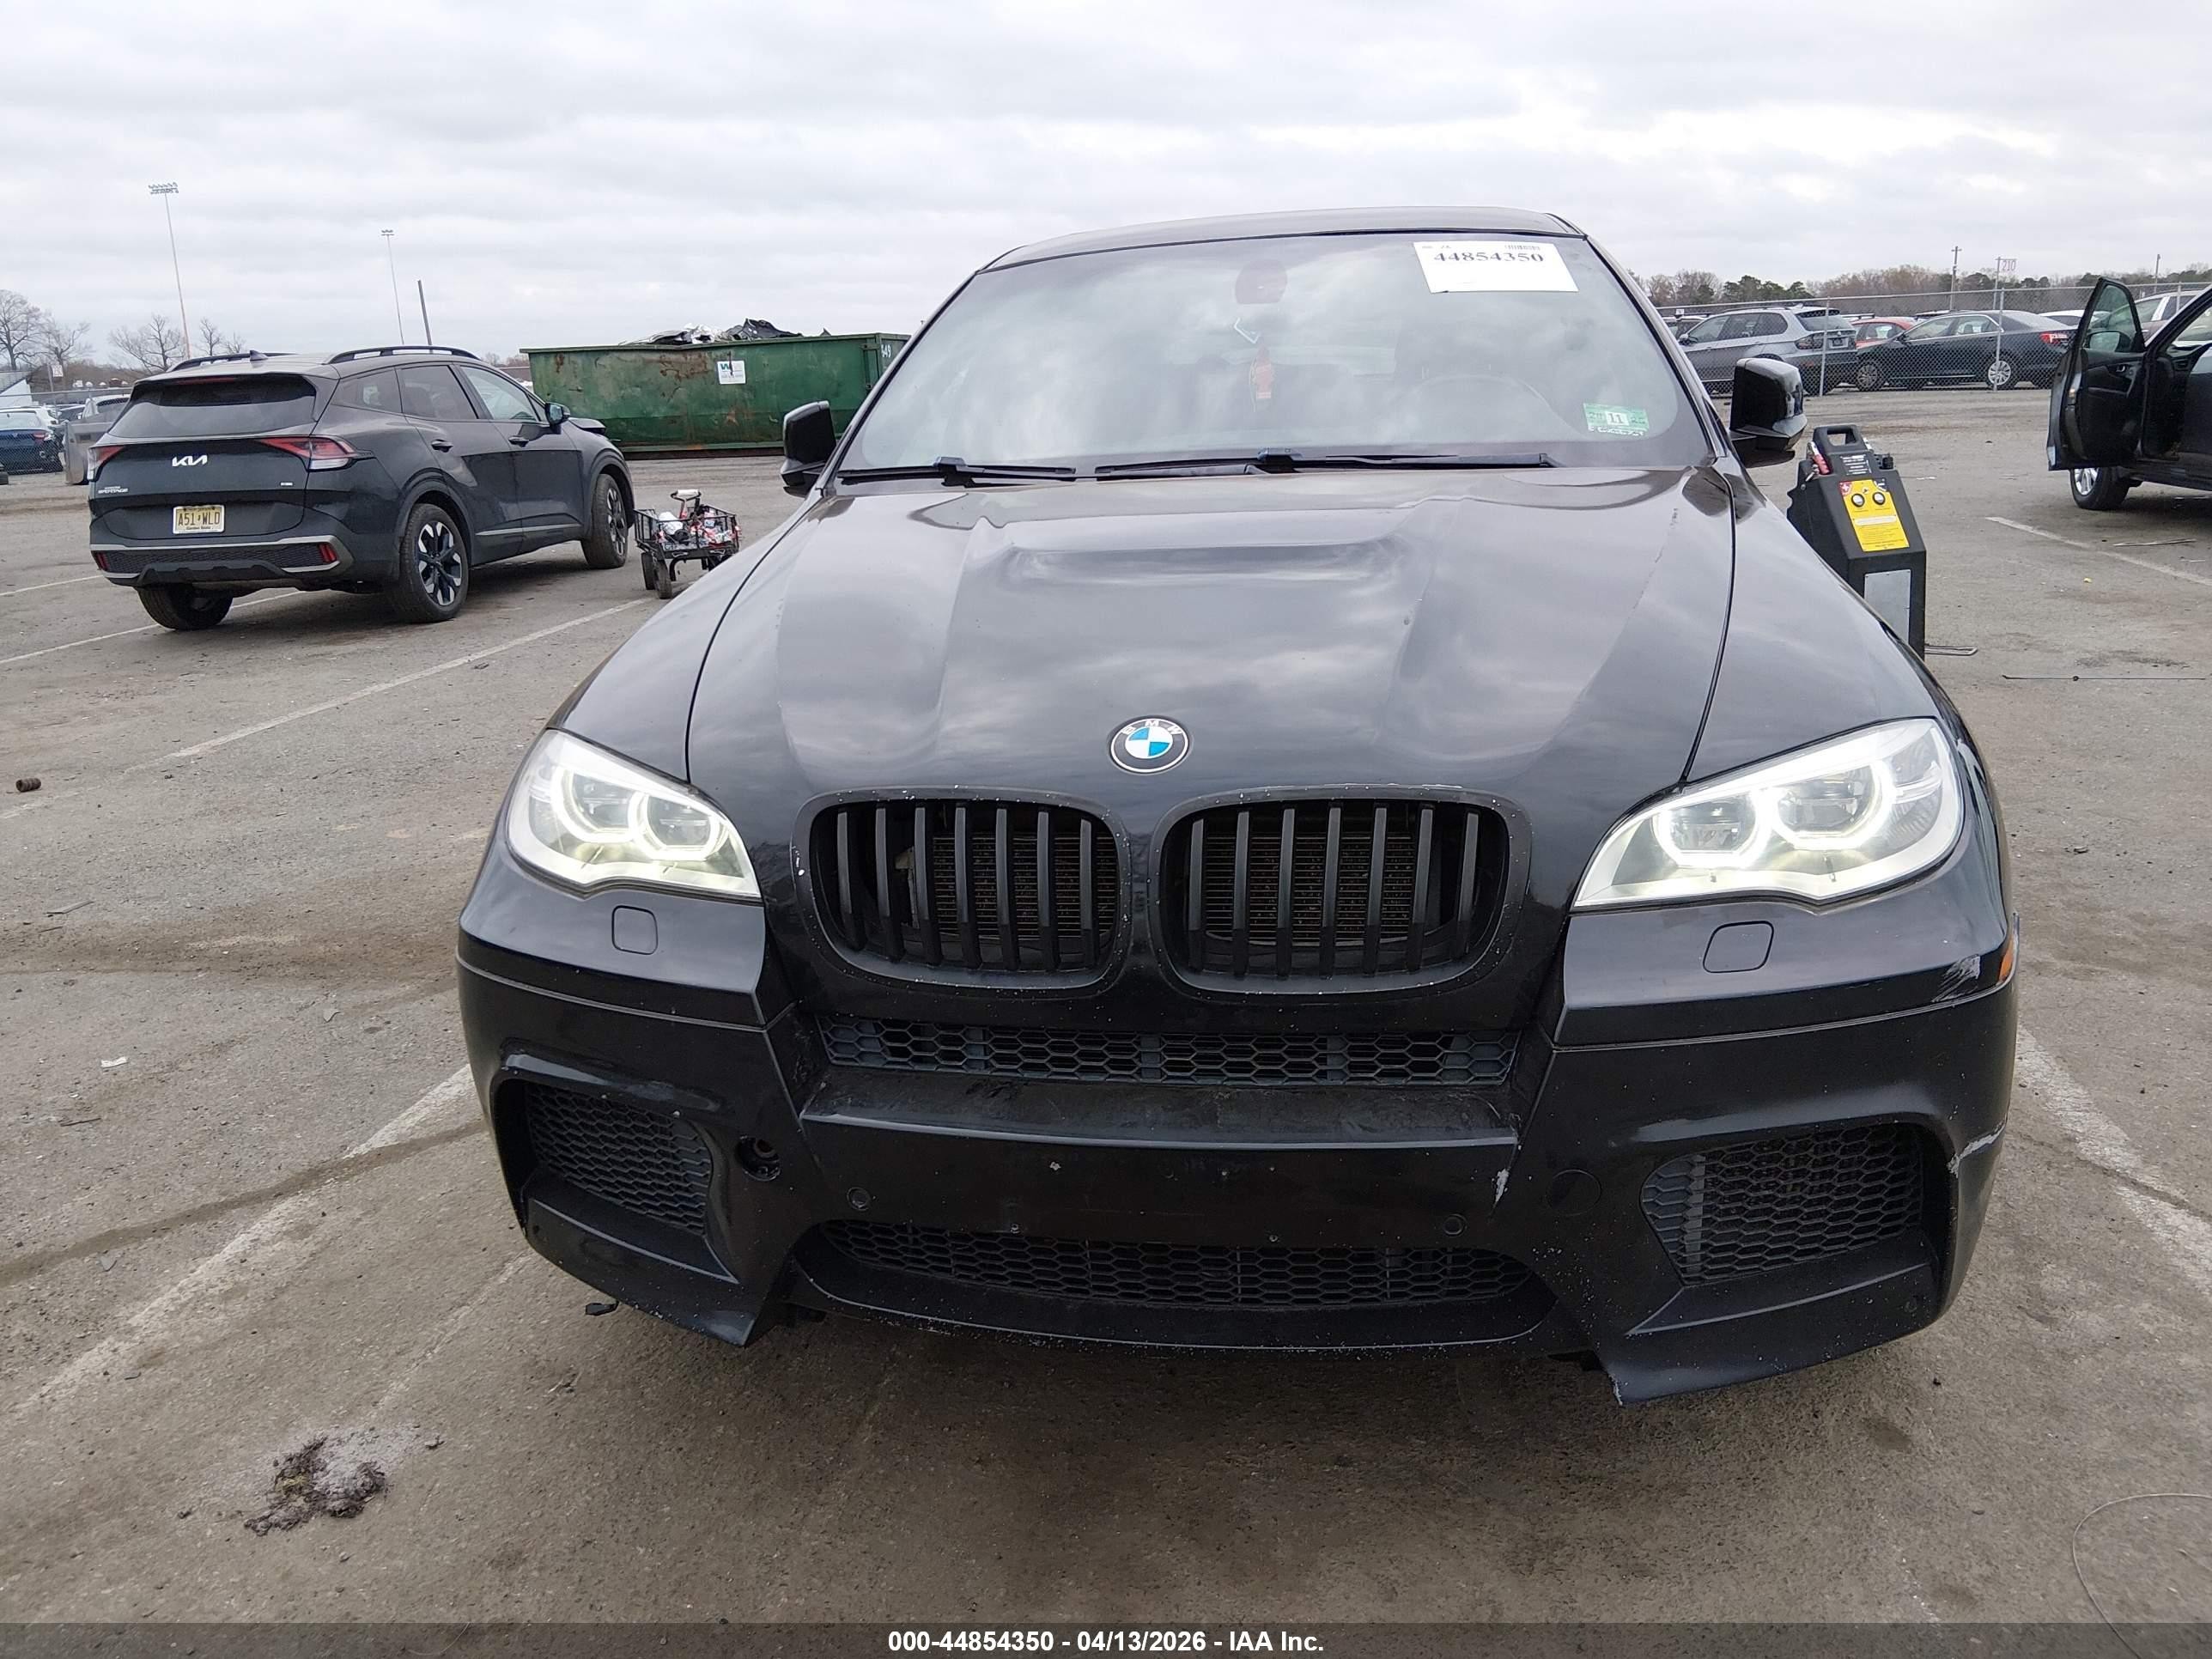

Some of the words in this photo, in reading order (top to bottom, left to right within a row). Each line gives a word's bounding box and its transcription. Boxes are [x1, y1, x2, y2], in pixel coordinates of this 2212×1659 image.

[1433, 252, 1545, 262] 44854350
[2002, 259, 2016, 270] 210
[1607, 413, 1624, 423] 11
[178, 513, 195, 526] A51
[1121, 720, 1183, 736] BMW
